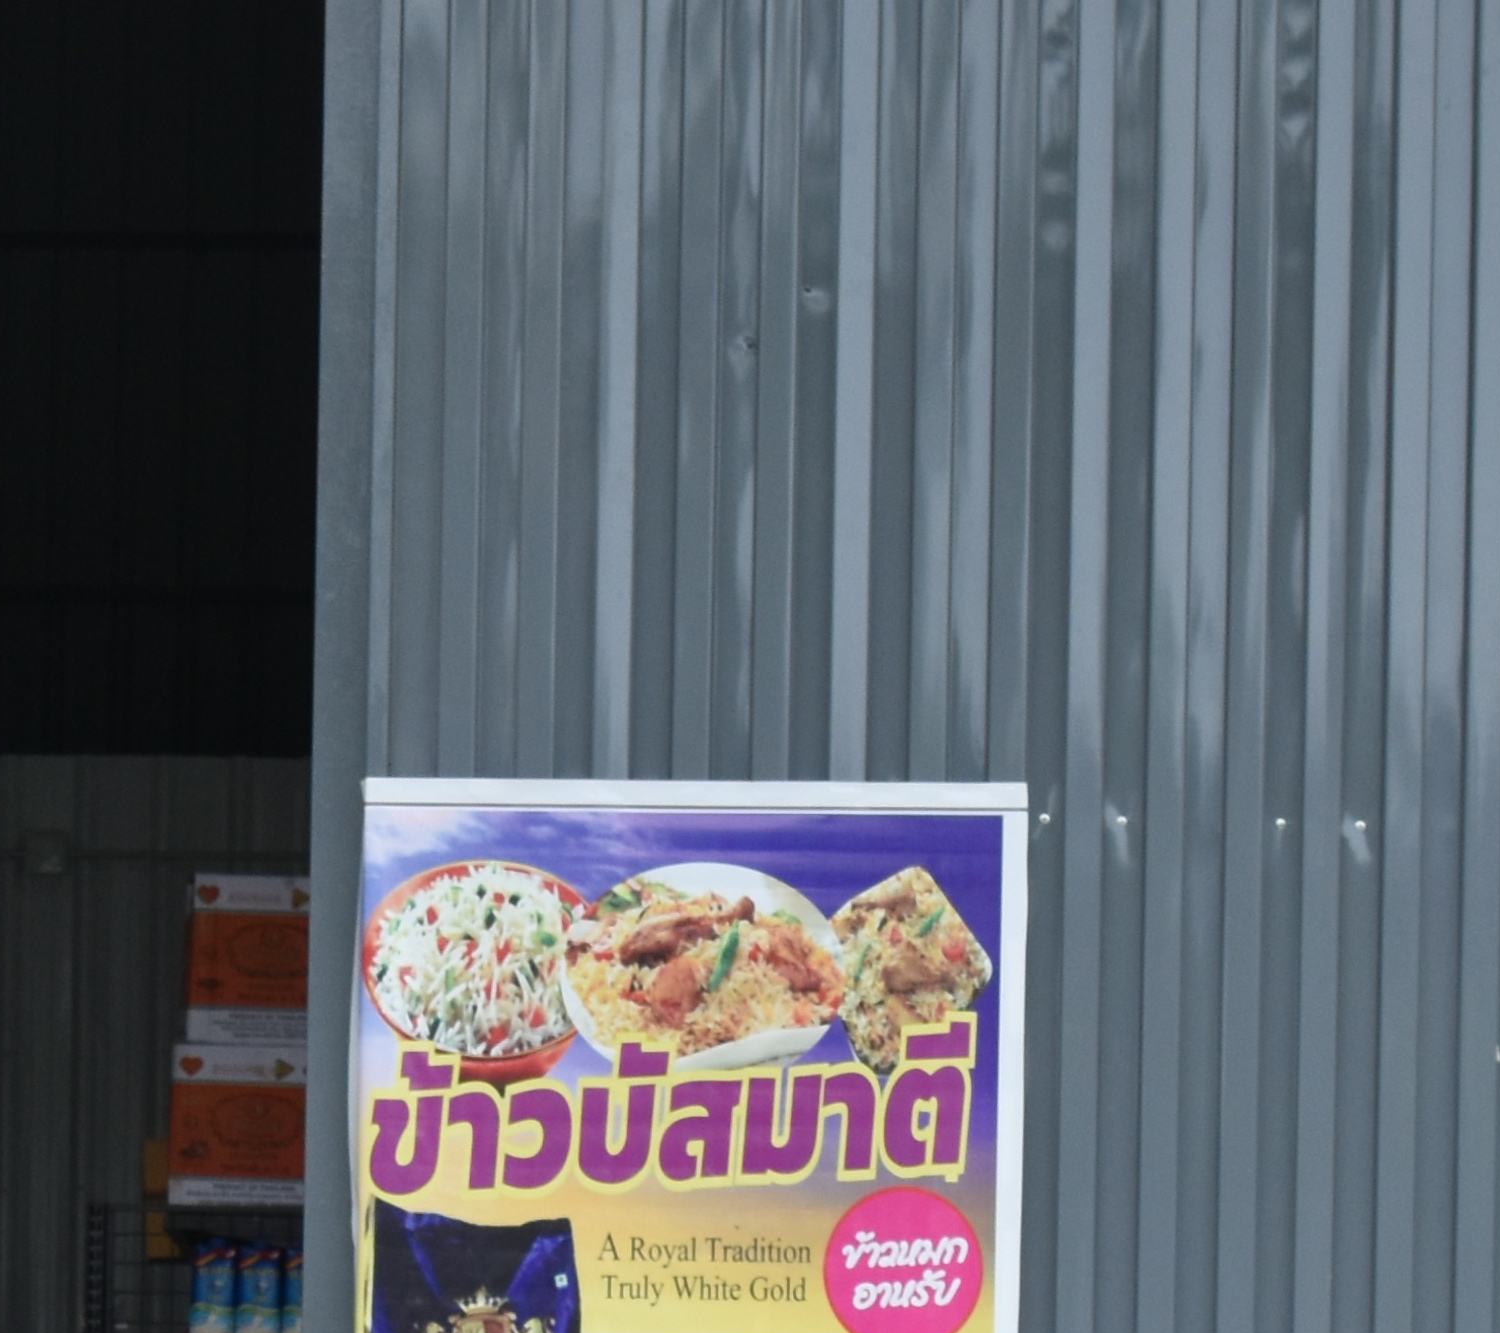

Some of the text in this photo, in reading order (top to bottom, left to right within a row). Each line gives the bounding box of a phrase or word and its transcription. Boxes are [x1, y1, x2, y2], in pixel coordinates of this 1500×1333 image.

[367, 1012, 978, 1197] ข้าวบัสมาตี
[598, 1232, 812, 1270] A Royal Tradition
[602, 1274, 807, 1307] Truly White Gold
